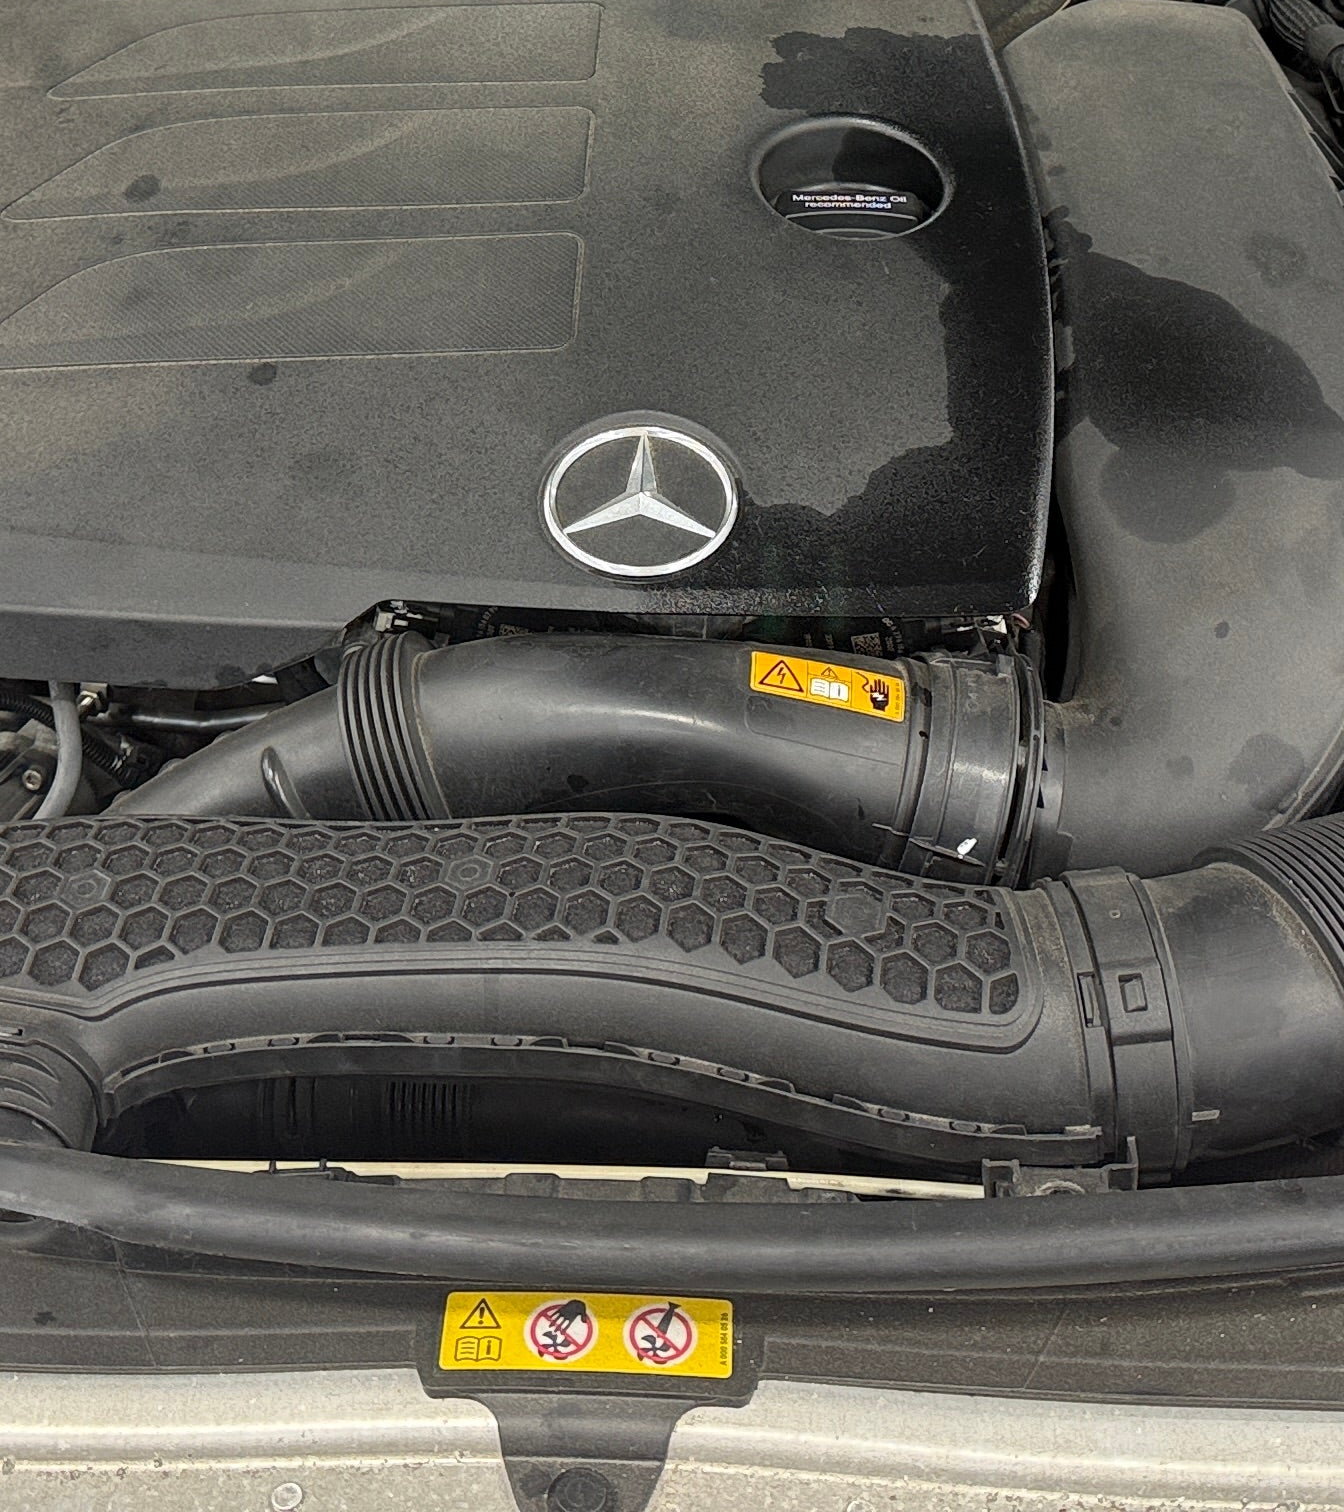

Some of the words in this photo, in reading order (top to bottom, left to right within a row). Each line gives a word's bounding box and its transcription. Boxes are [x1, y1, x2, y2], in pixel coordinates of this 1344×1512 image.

[792, 194, 887, 202] Mercedes-Benz
[889, 195, 907, 203] Oil
[804, 201, 892, 209] recommended
